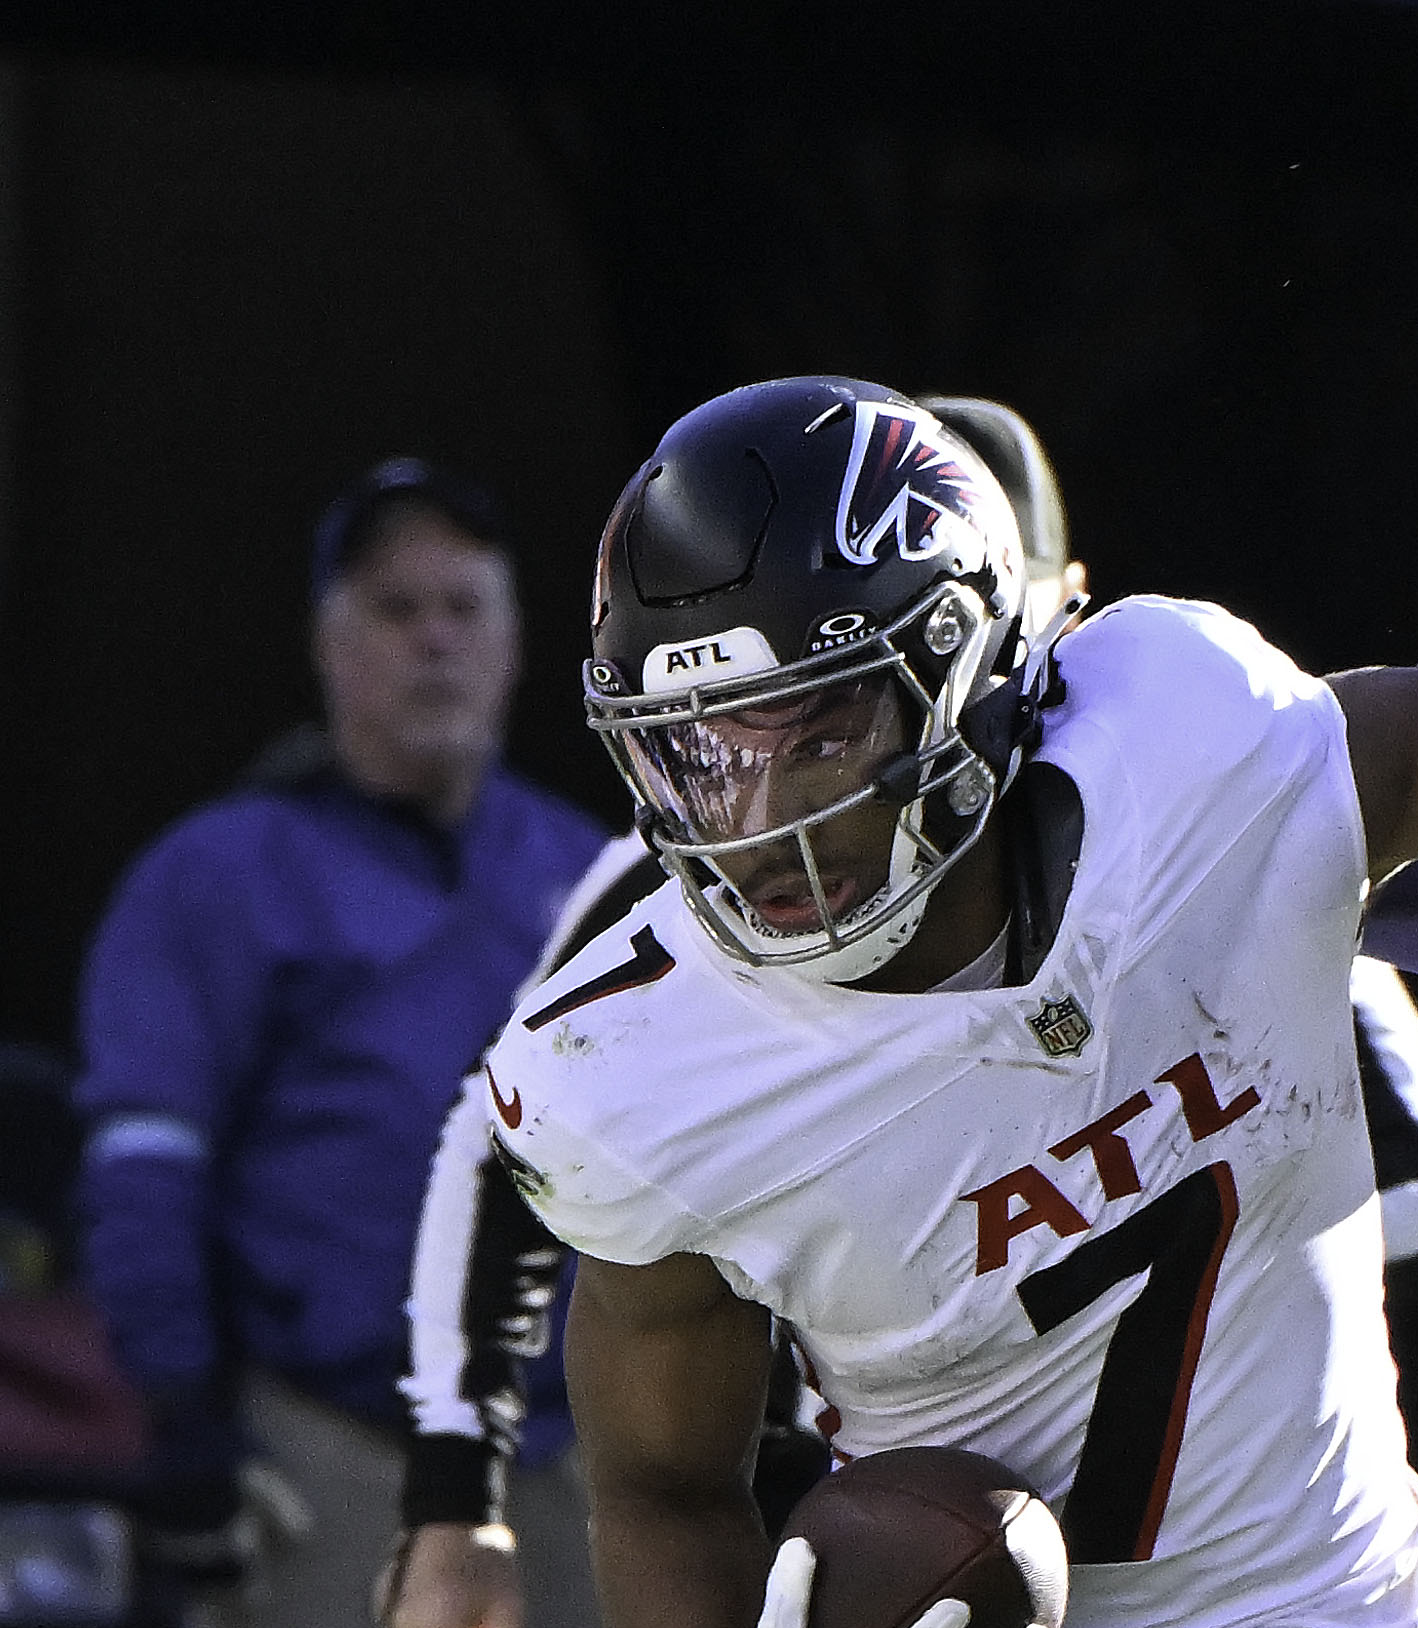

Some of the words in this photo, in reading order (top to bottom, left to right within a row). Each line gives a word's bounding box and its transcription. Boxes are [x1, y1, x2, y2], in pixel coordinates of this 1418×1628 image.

[666, 642, 732, 674] ATL
[521, 924, 677, 1032] 7
[1045, 1017, 1086, 1048] NFL
[958, 1052, 1262, 1277] ATL
[1016, 1160, 1240, 1565] 7
